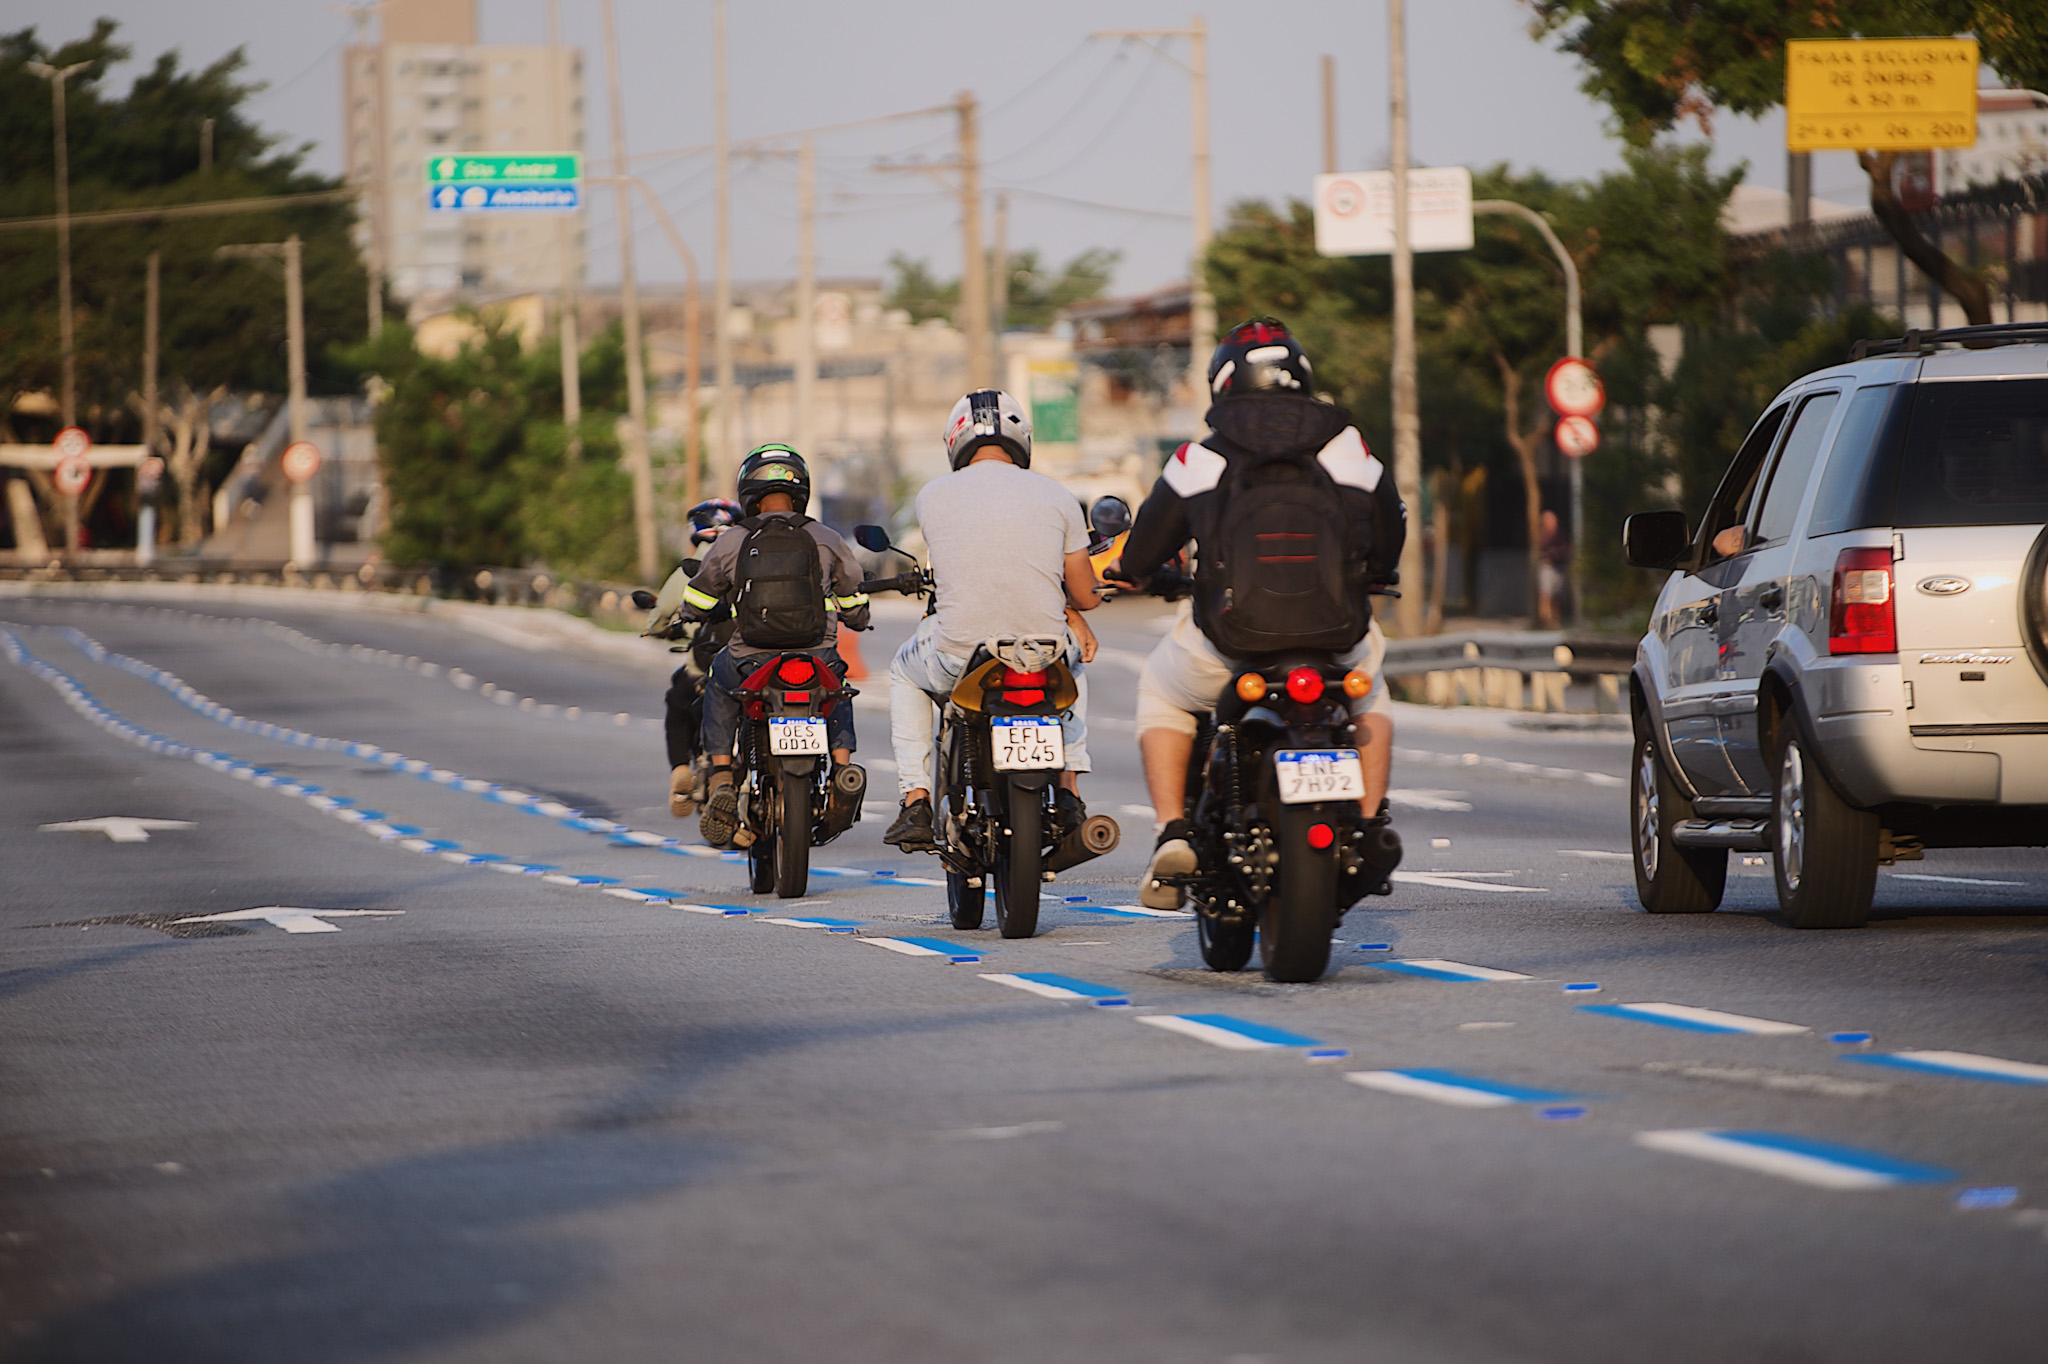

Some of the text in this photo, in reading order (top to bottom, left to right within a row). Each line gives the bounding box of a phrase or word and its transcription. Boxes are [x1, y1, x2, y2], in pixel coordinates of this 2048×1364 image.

[782, 725, 815, 738] OES
[1009, 727, 1047, 744] EFL
[1003, 744, 1055, 763] 7C45
[1291, 775, 1354, 794] 7H92
